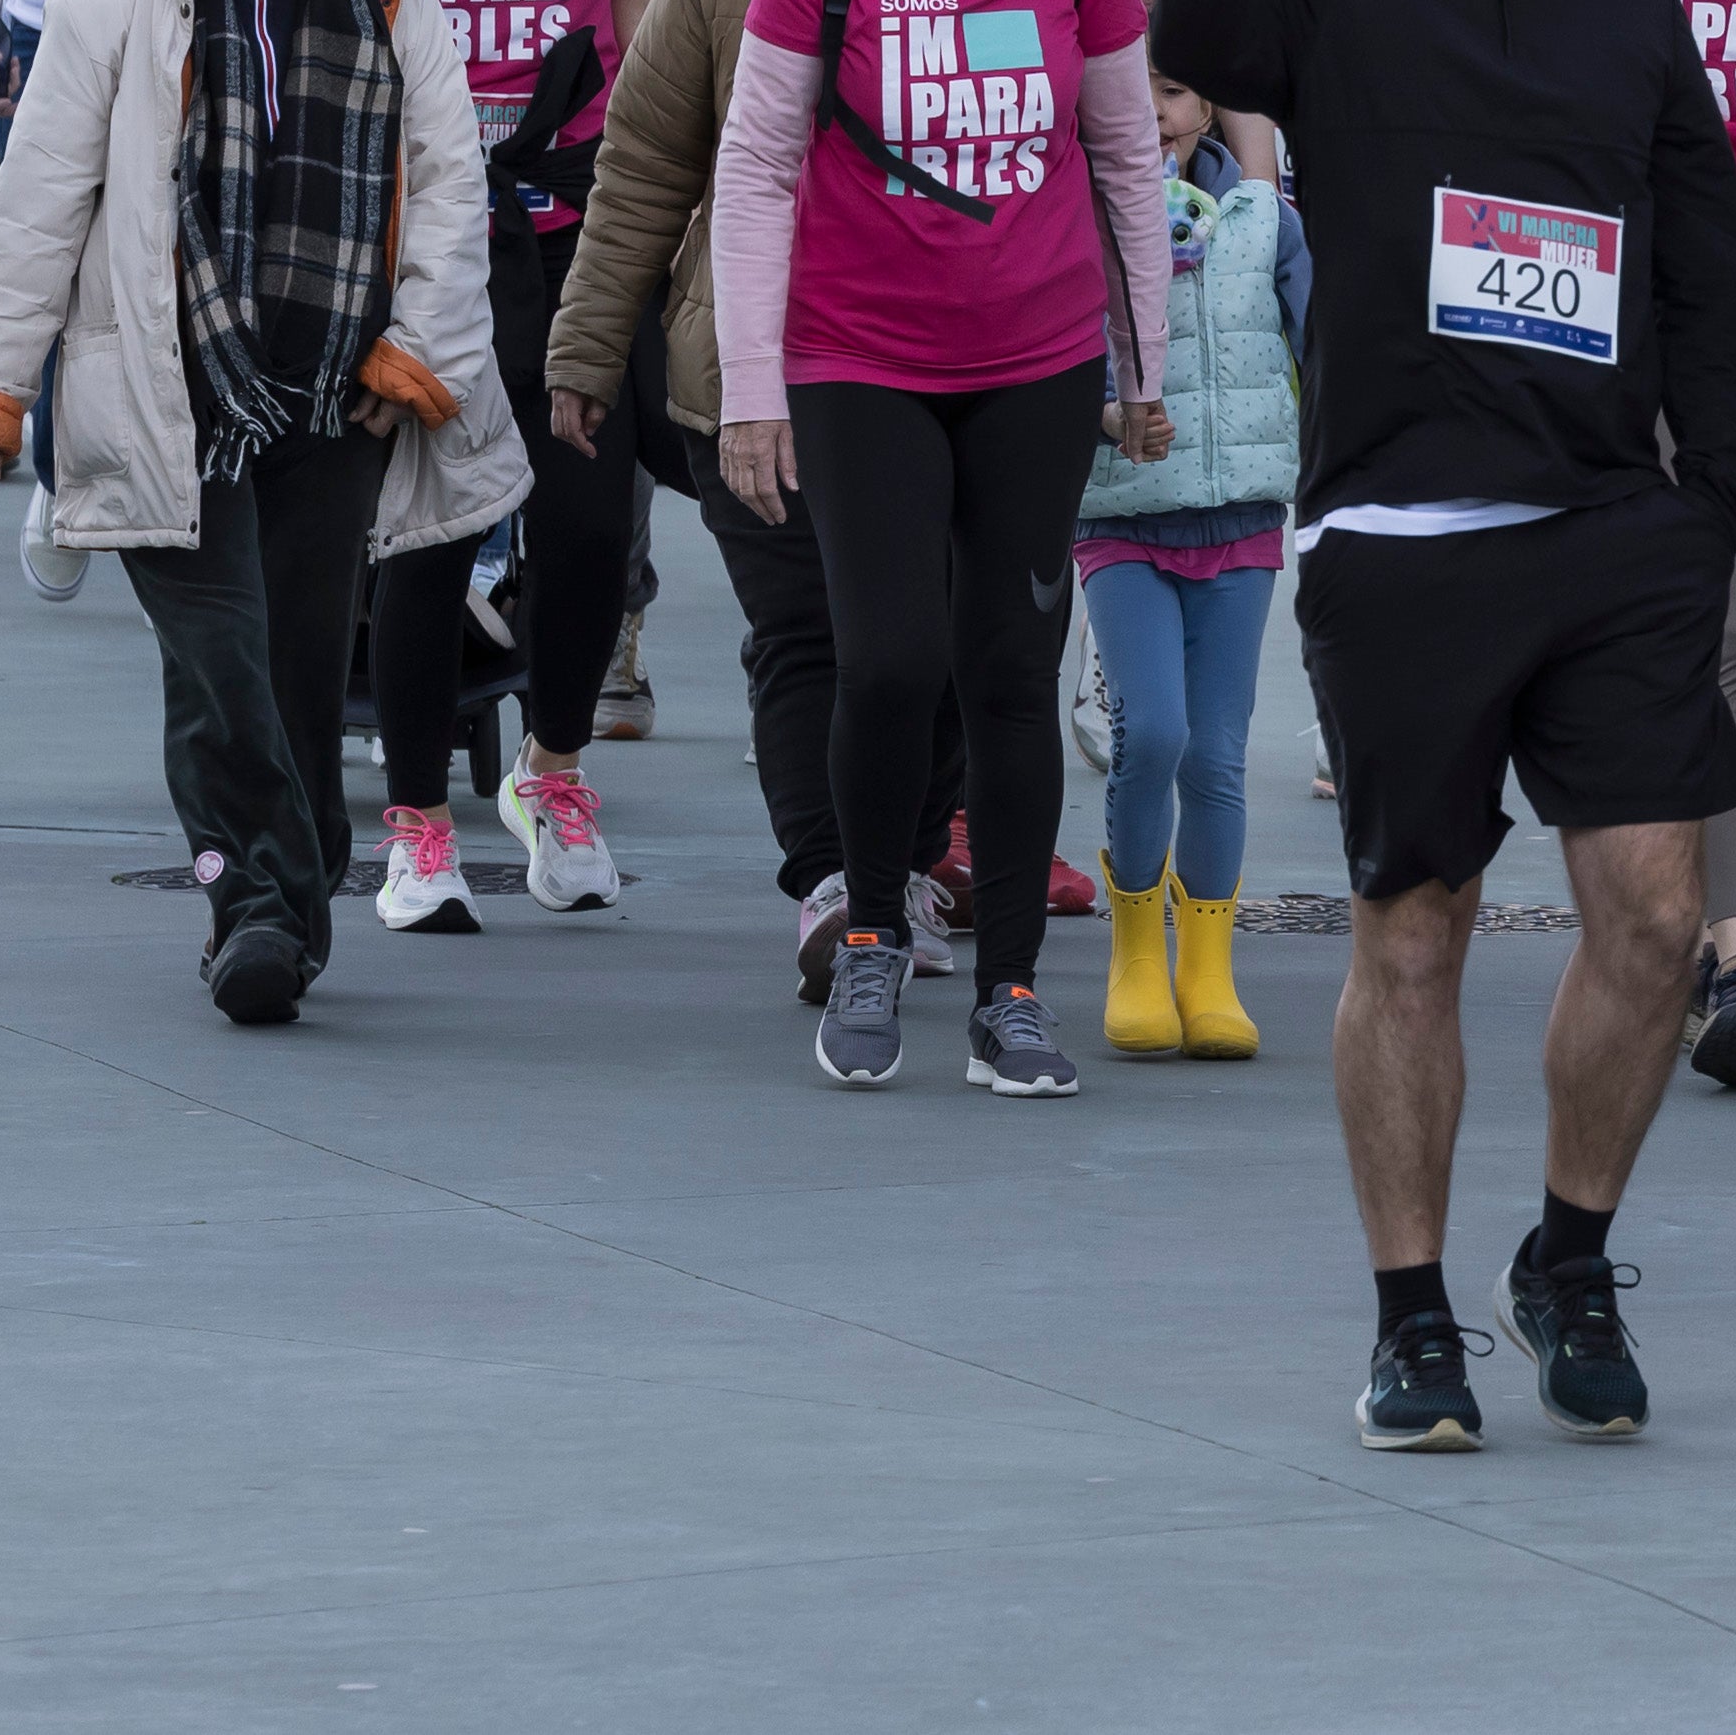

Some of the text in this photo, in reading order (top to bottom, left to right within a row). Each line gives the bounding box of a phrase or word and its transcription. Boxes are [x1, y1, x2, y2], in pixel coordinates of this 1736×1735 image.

[910, 72, 1054, 141] PARA
[912, 137, 1047, 198] BLES
[1498, 210, 1598, 248] VI MARCHA
[1540, 240, 1598, 271] MUJER
[1477, 258, 1580, 318] 420
